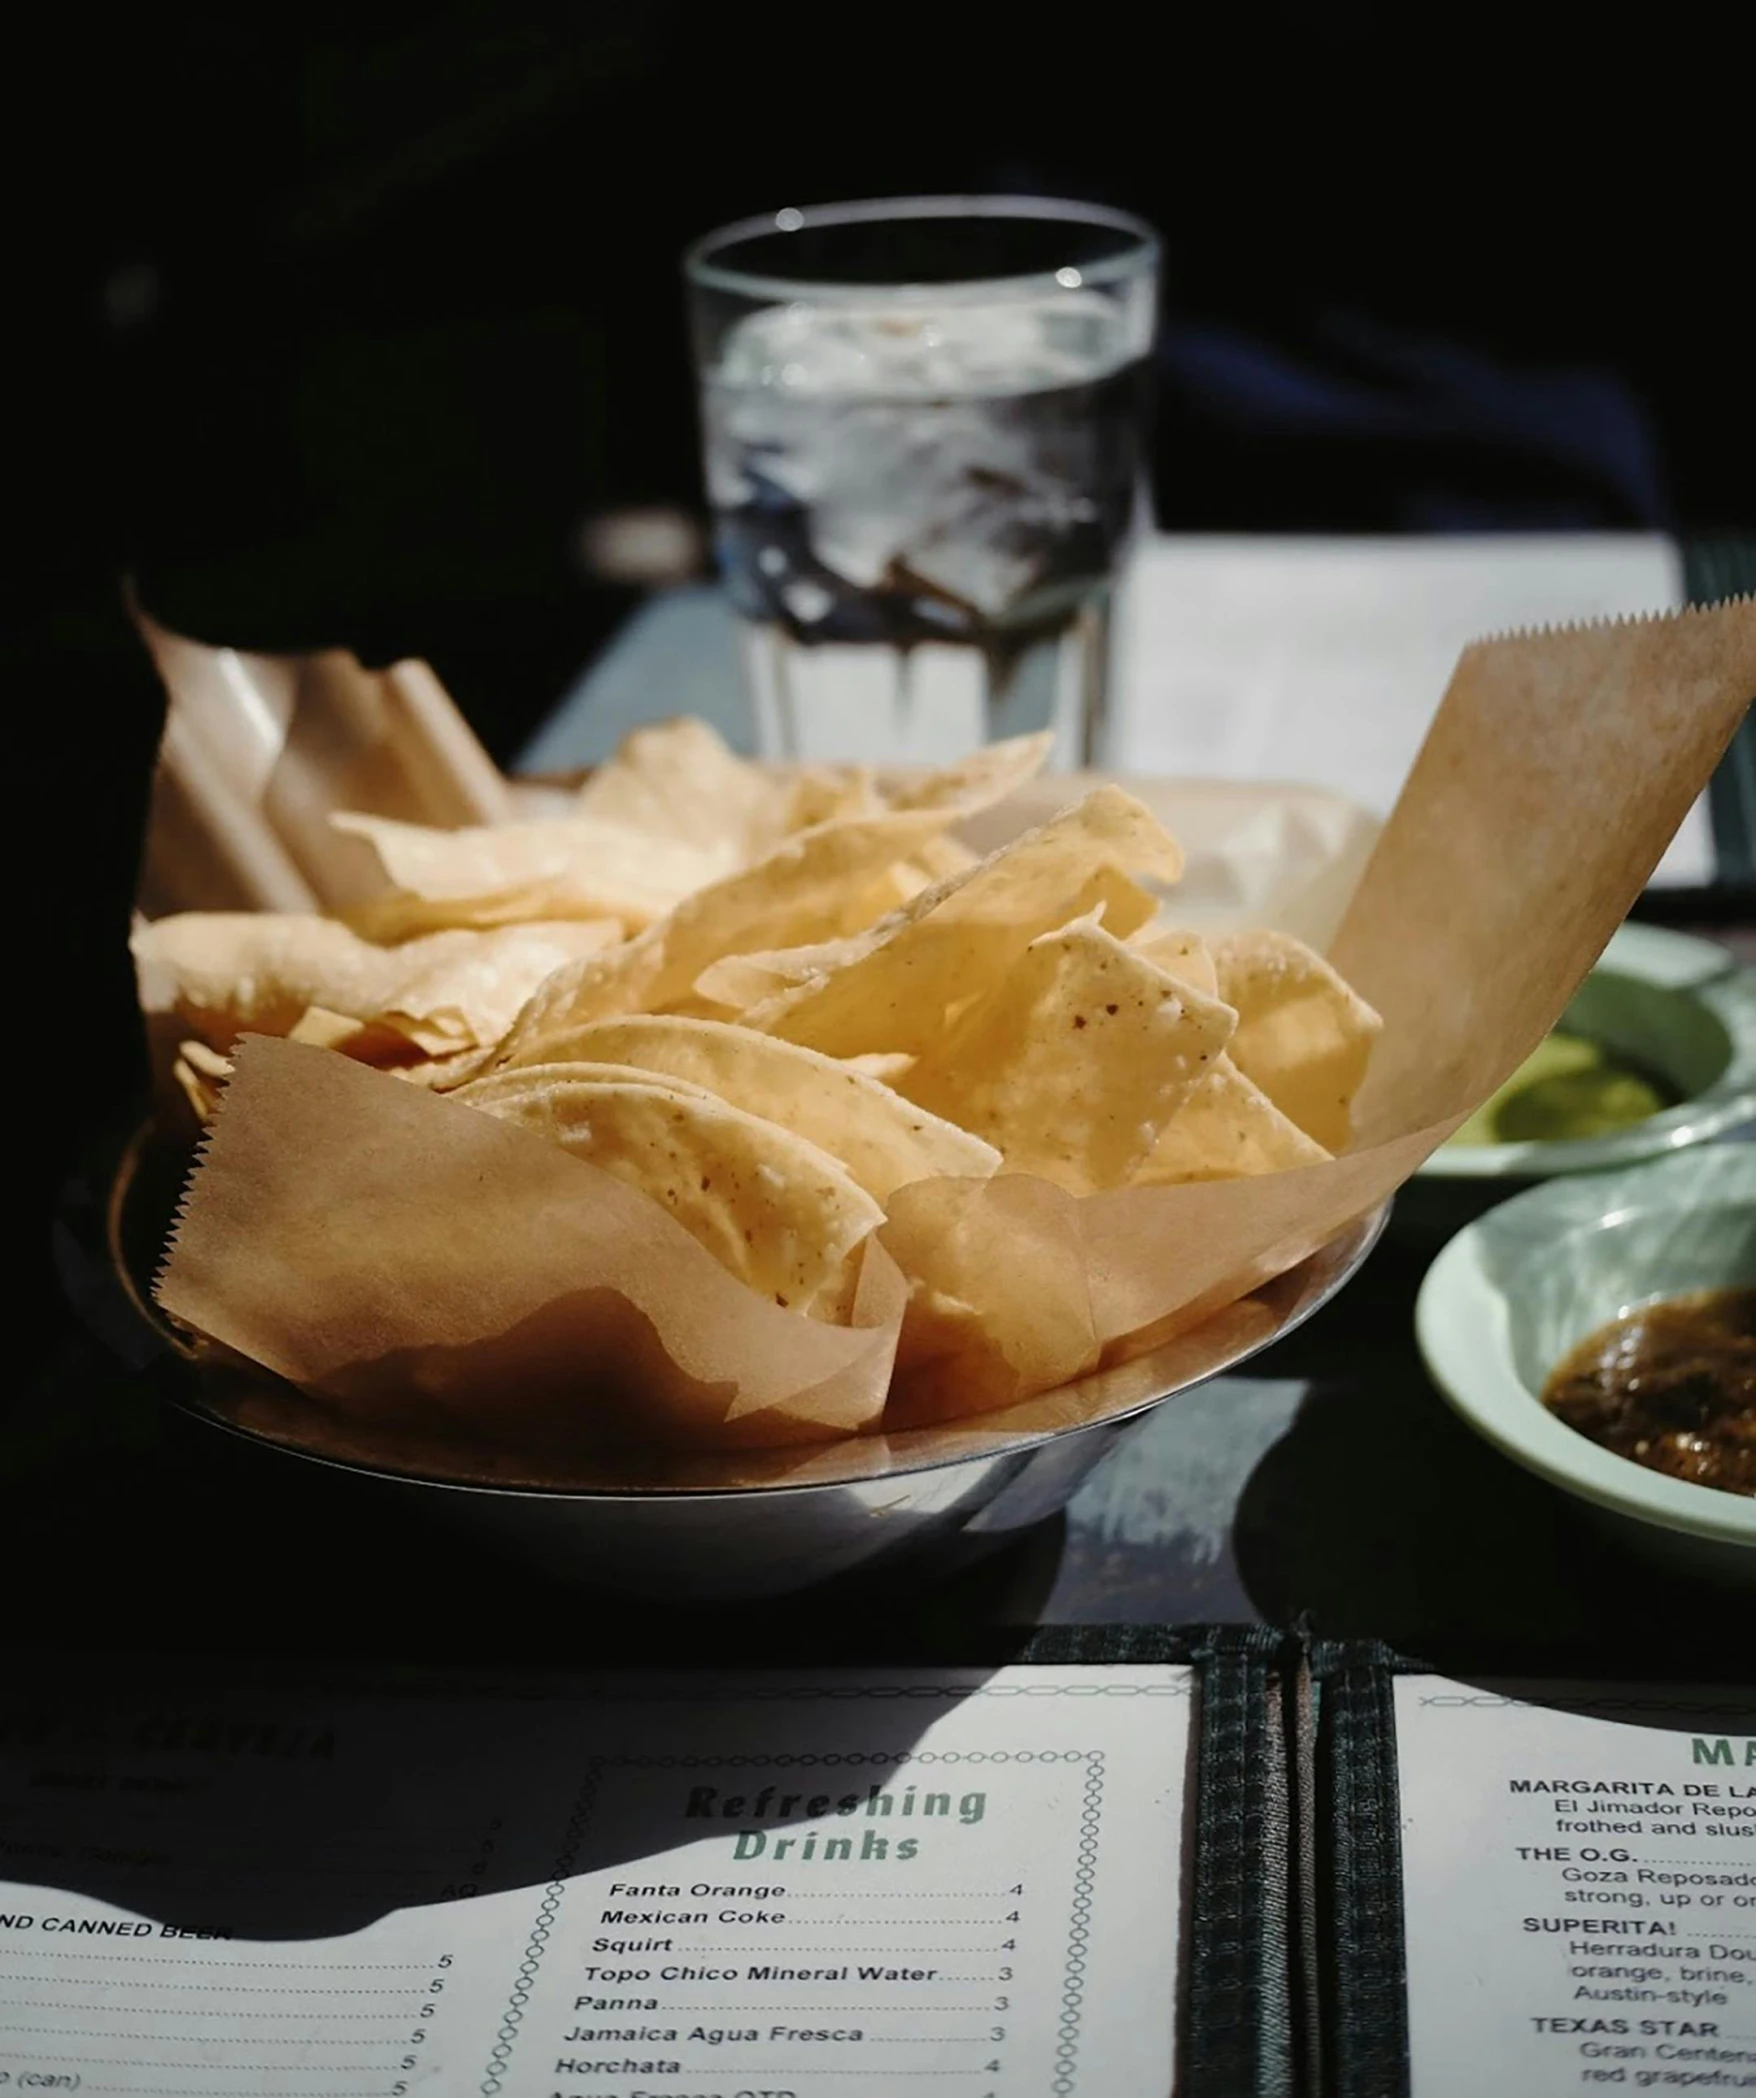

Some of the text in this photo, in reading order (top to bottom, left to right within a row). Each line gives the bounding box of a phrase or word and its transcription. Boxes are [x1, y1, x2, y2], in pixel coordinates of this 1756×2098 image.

[1509, 1780, 1674, 1796] MARGARITA
[1683, 1784, 1721, 1798] DE
[686, 1784, 986, 1825] Refreshing
[1555, 1800, 1578, 1812] El
[1587, 1800, 1684, 1816] Jimador
[1556, 1819, 1756, 1838] frothed and slus
[732, 1829, 919, 1861] Drinks
[1515, 1847, 1638, 1862] THE O.G.
[1562, 1867, 1628, 1883] Goza
[609, 1883, 1023, 1900] Fanta Orange 4
[1564, 1889, 1651, 1908] strong,
[1660, 1892, 1691, 1908] up
[1700, 1893, 1726, 1907] or
[600, 1909, 1020, 1924] Mexican Coke 4
[42, 1917, 152, 1937] CANNED
[160, 1923, 233, 1940] BEER
[1523, 1917, 1677, 1936] SUPERITA!
[592, 1937, 1016, 1954] Squirt 4
[1570, 1940, 1701, 1959] Herradura
[438, 1954, 453, 1969] 5
[585, 1966, 1013, 1984] Topo Chico Mineral Water 3
[1571, 1965, 1753, 1986] orange, brine,
[429, 1979, 445, 1993] 5
[574, 1996, 1009, 2011] Panna 3
[1573, 1985, 1728, 2008] Austin-style
[420, 2003, 435, 2018] 5
[411, 2028, 426, 2044] 5
[563, 2026, 1006, 2045] Jamaica Agua Fresca 3
[1530, 2017, 1719, 2037] TEXAS STAR
[1579, 2041, 1648, 2059] Gran
[401, 2054, 417, 2070] 5
[554, 2058, 1000, 2074] Horchata 4
[18, 2070, 81, 2092] (can)
[392, 2080, 408, 2096] 5
[1582, 2067, 1627, 2083] red
